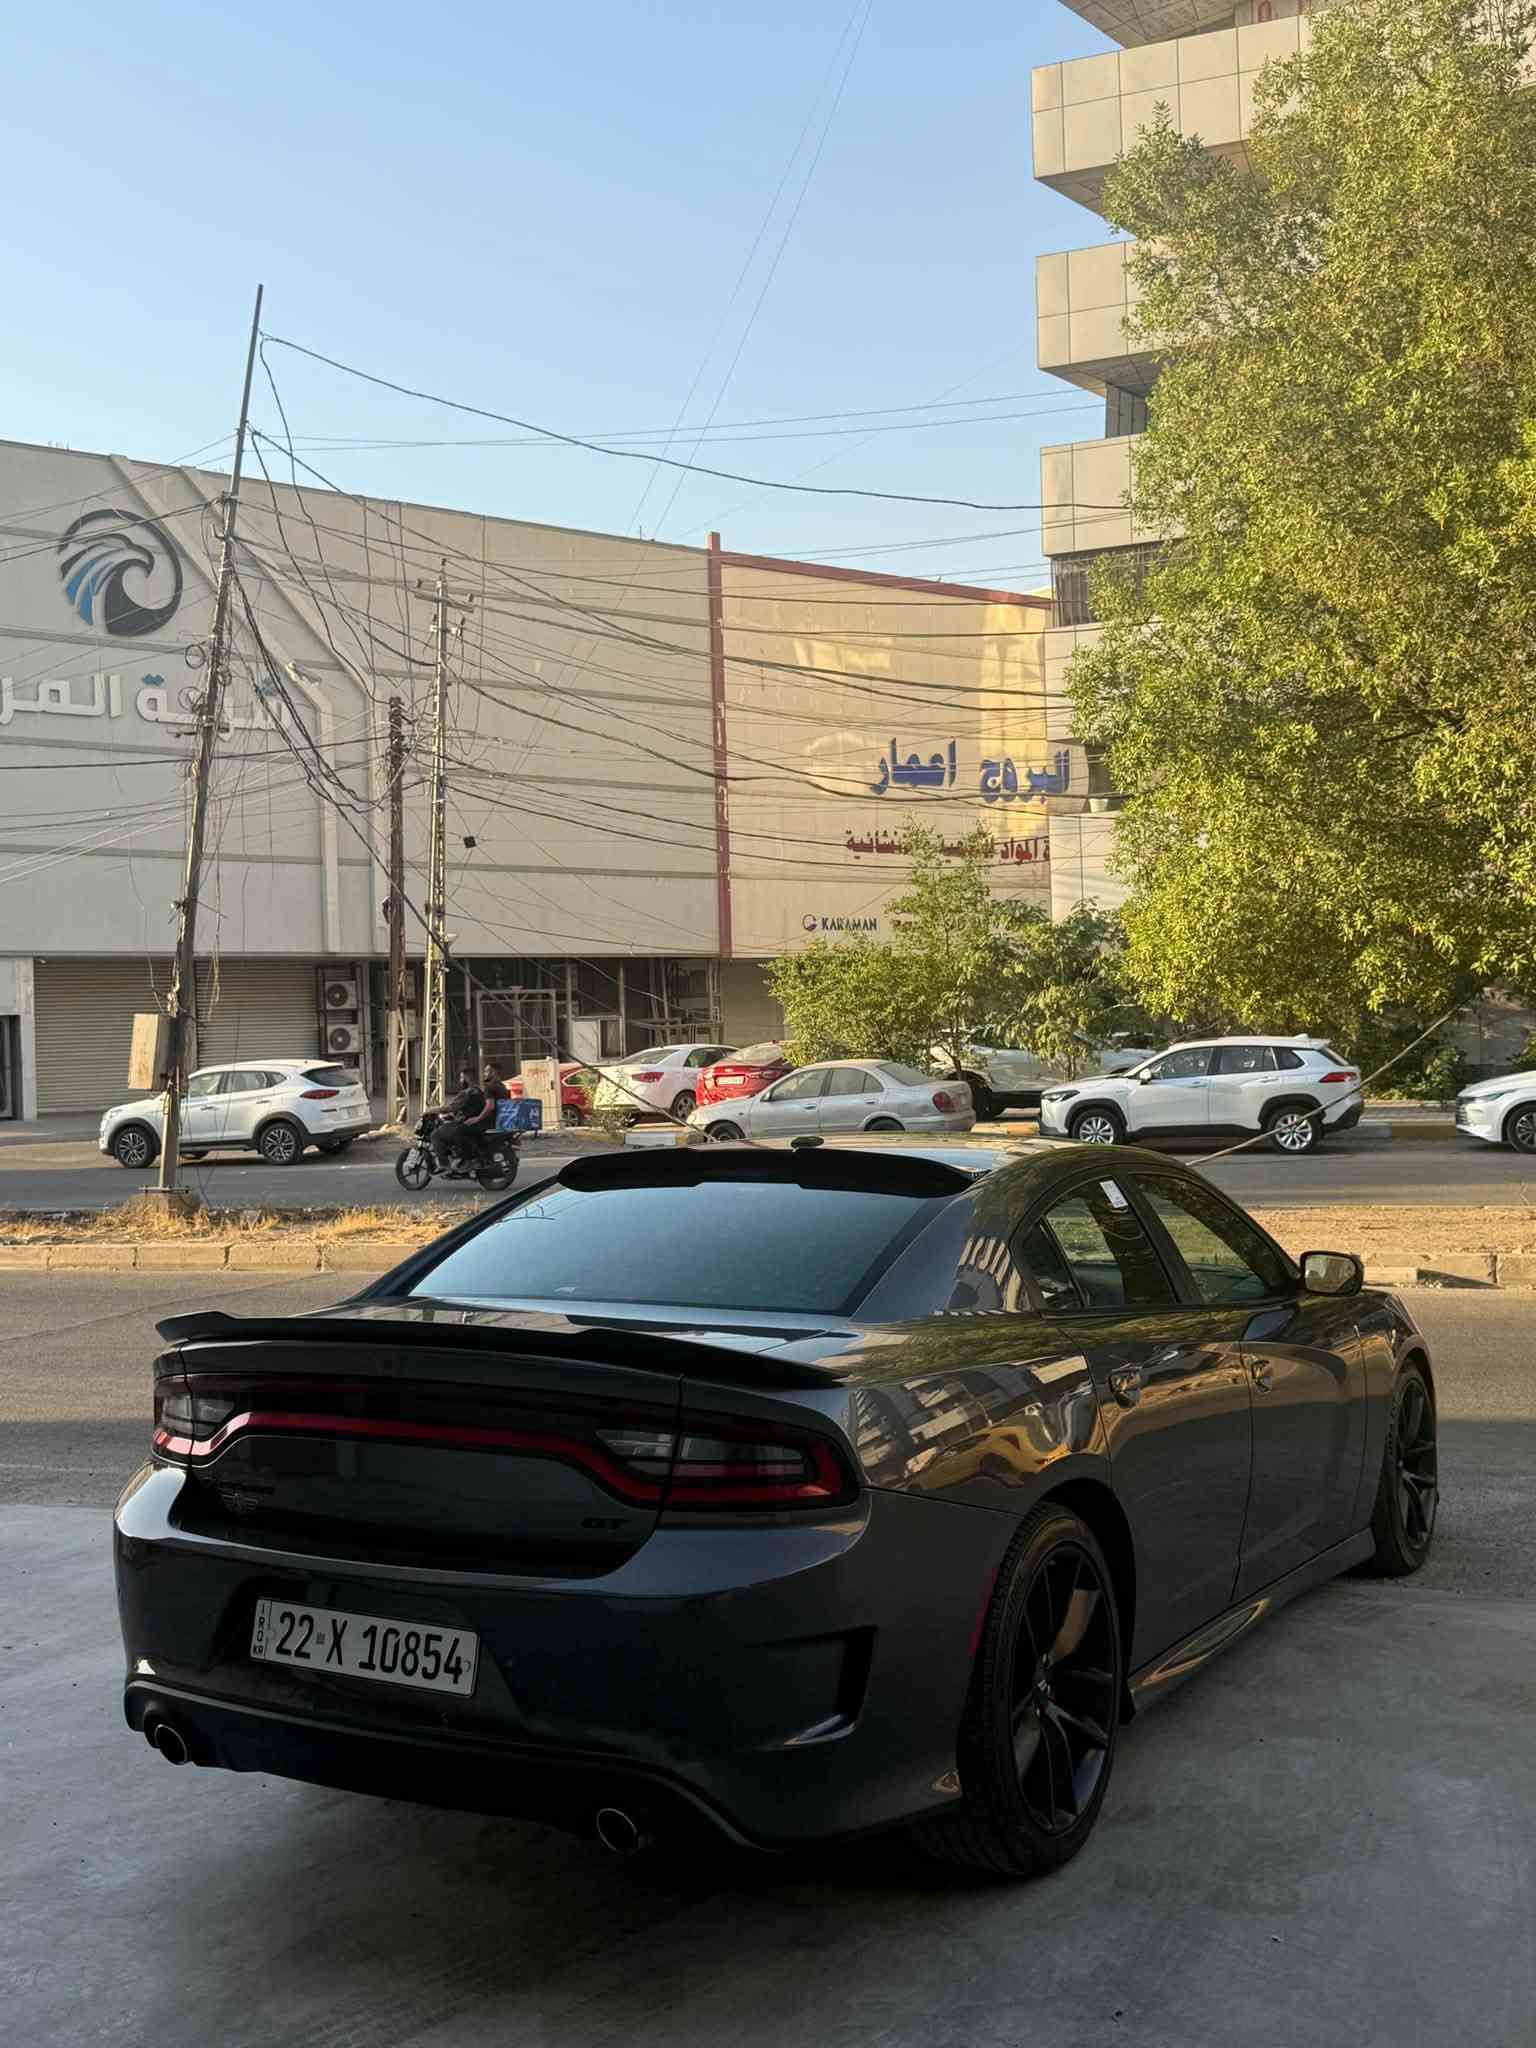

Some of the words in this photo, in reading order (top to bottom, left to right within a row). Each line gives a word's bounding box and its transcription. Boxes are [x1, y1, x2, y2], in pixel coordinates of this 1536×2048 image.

[869, 737, 956, 795] اعمار
[980, 749, 1069, 804] البروج
[821, 917, 877, 931] KARAMAN
[275, 1611, 314, 1659] 22
[325, 1618, 347, 1665] X
[358, 1625, 462, 1684] 10854
